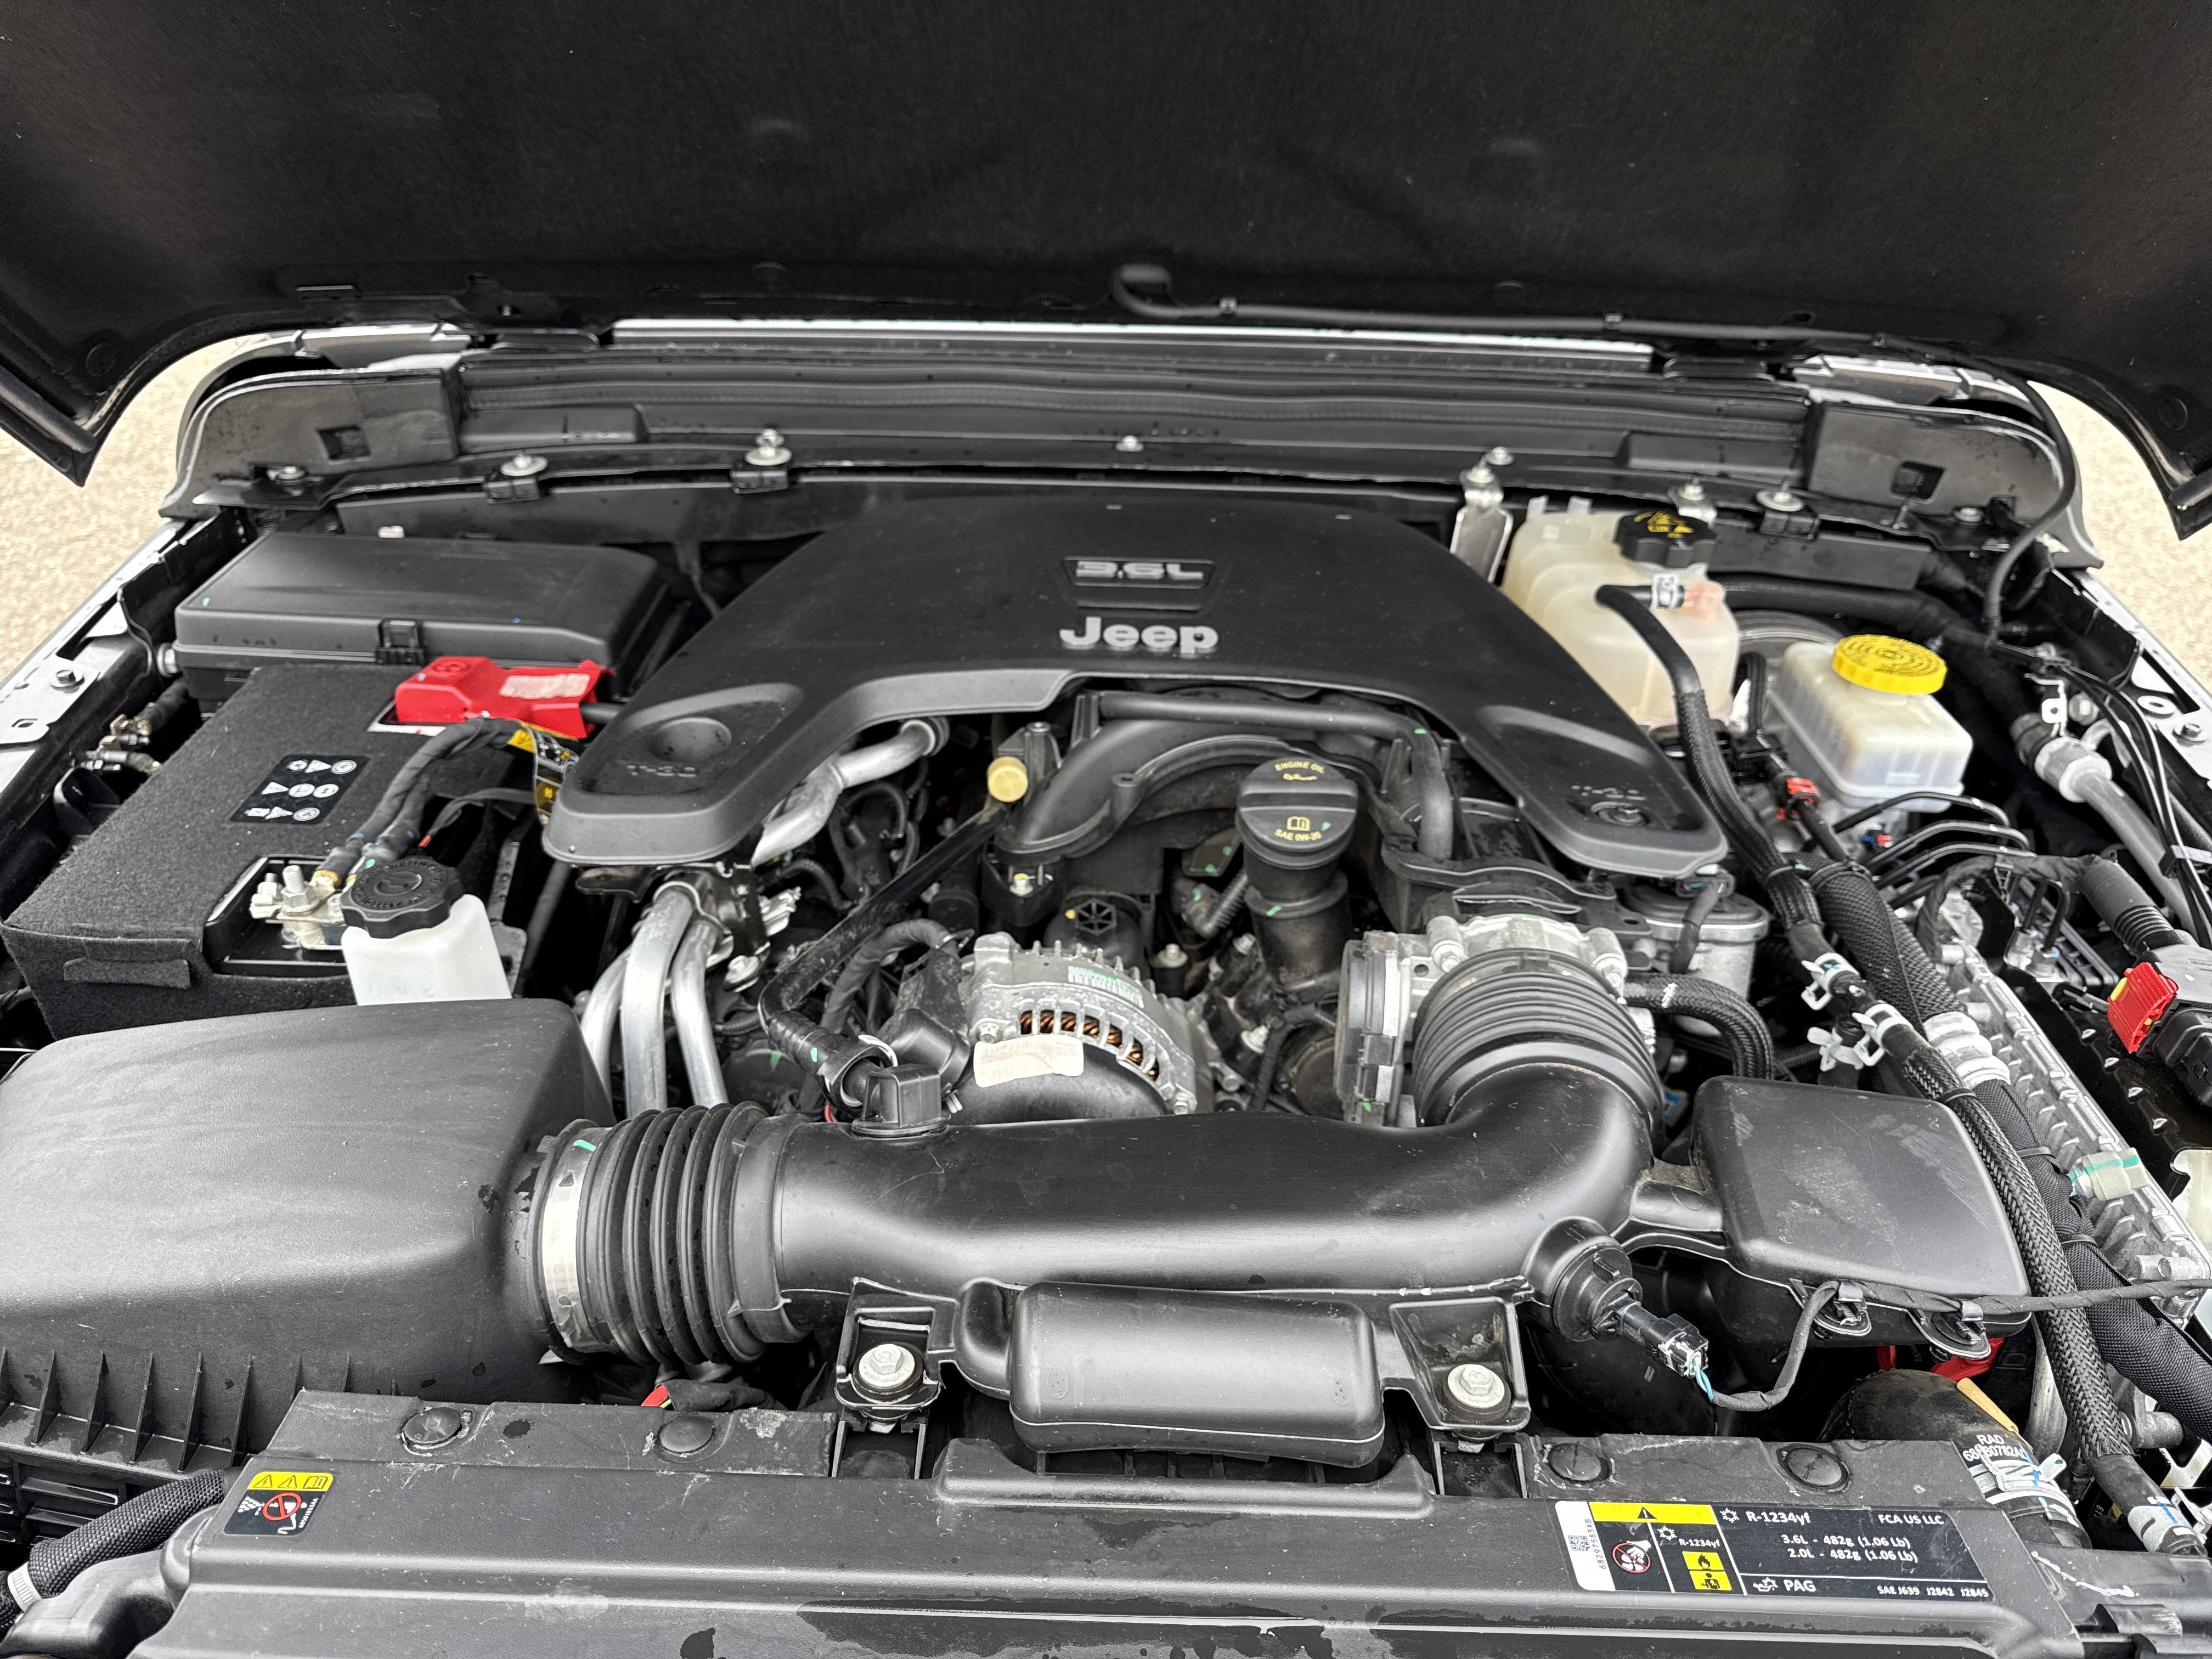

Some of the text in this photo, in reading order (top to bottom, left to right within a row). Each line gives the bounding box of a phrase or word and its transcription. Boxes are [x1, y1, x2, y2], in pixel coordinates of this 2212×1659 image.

[1076, 560, 1204, 580] 3.6L
[1059, 616, 1220, 656] Jeep
[1274, 761, 1325, 774] ENGINE OIL
[1274, 828, 1322, 842] SAE 0W-20
[1976, 1434, 2005, 1445] RAD
[1745, 1511, 1811, 1526] R-1234yf
[1877, 1514, 1944, 1525] FCA US LLC
[1584, 1519, 1607, 1570] 68297583AB
[1678, 1538, 1720, 1549] R-1234yf
[1781, 1534, 1809, 1544] 3.6L
[1823, 1536, 1855, 1547] 482g
[1857, 1536, 1889, 1548] (1.06
[1889, 1537, 1911, 1549] Lb)
[1787, 1548, 1815, 1559] 2.0L
[1830, 1549, 1861, 1561] 482g
[1864, 1549, 1897, 1561] (1.06
[1897, 1550, 1918, 1564] Lb)
[1783, 1579, 1816, 1592] PAG
[1877, 1585, 1897, 1595] SAE
